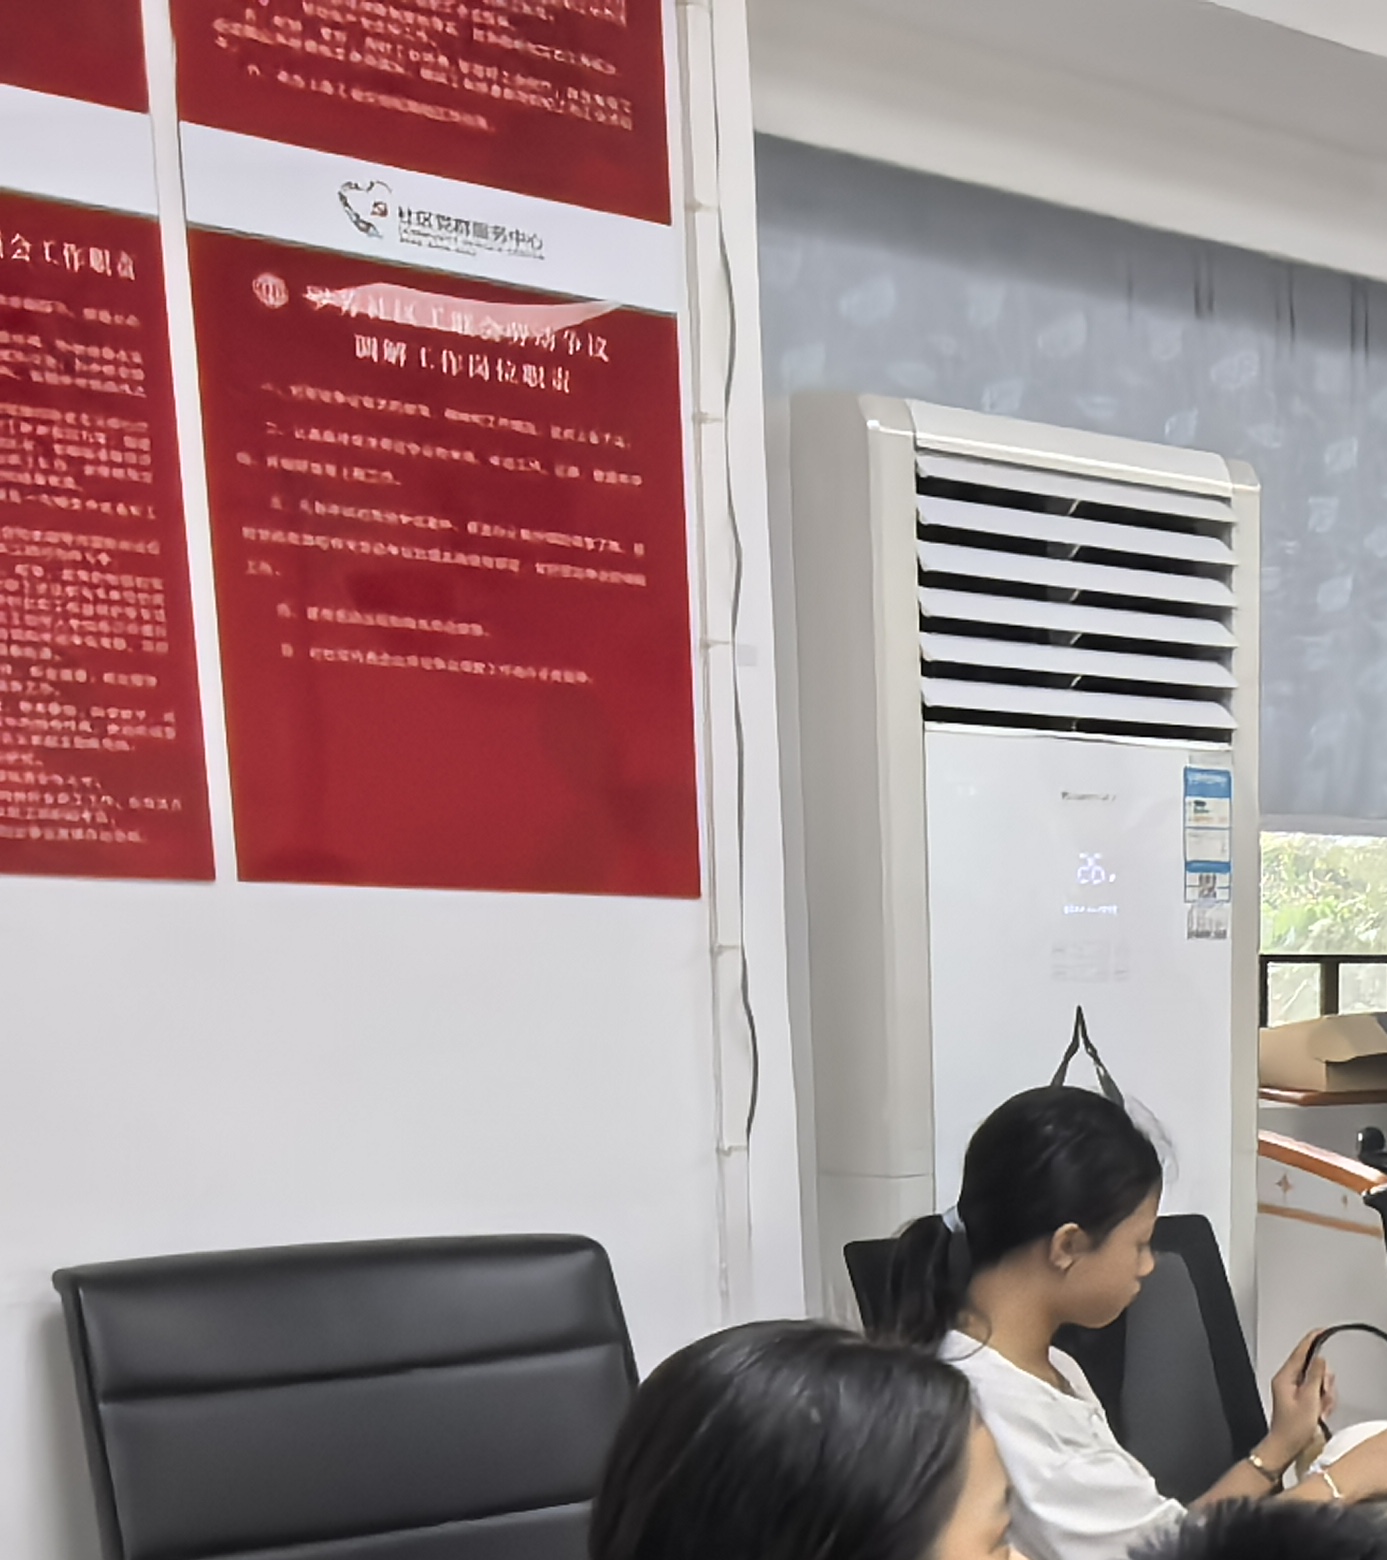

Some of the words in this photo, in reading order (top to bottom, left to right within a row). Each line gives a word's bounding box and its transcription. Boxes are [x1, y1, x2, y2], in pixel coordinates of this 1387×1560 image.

[0, 232, 136, 281] 会工作职责
